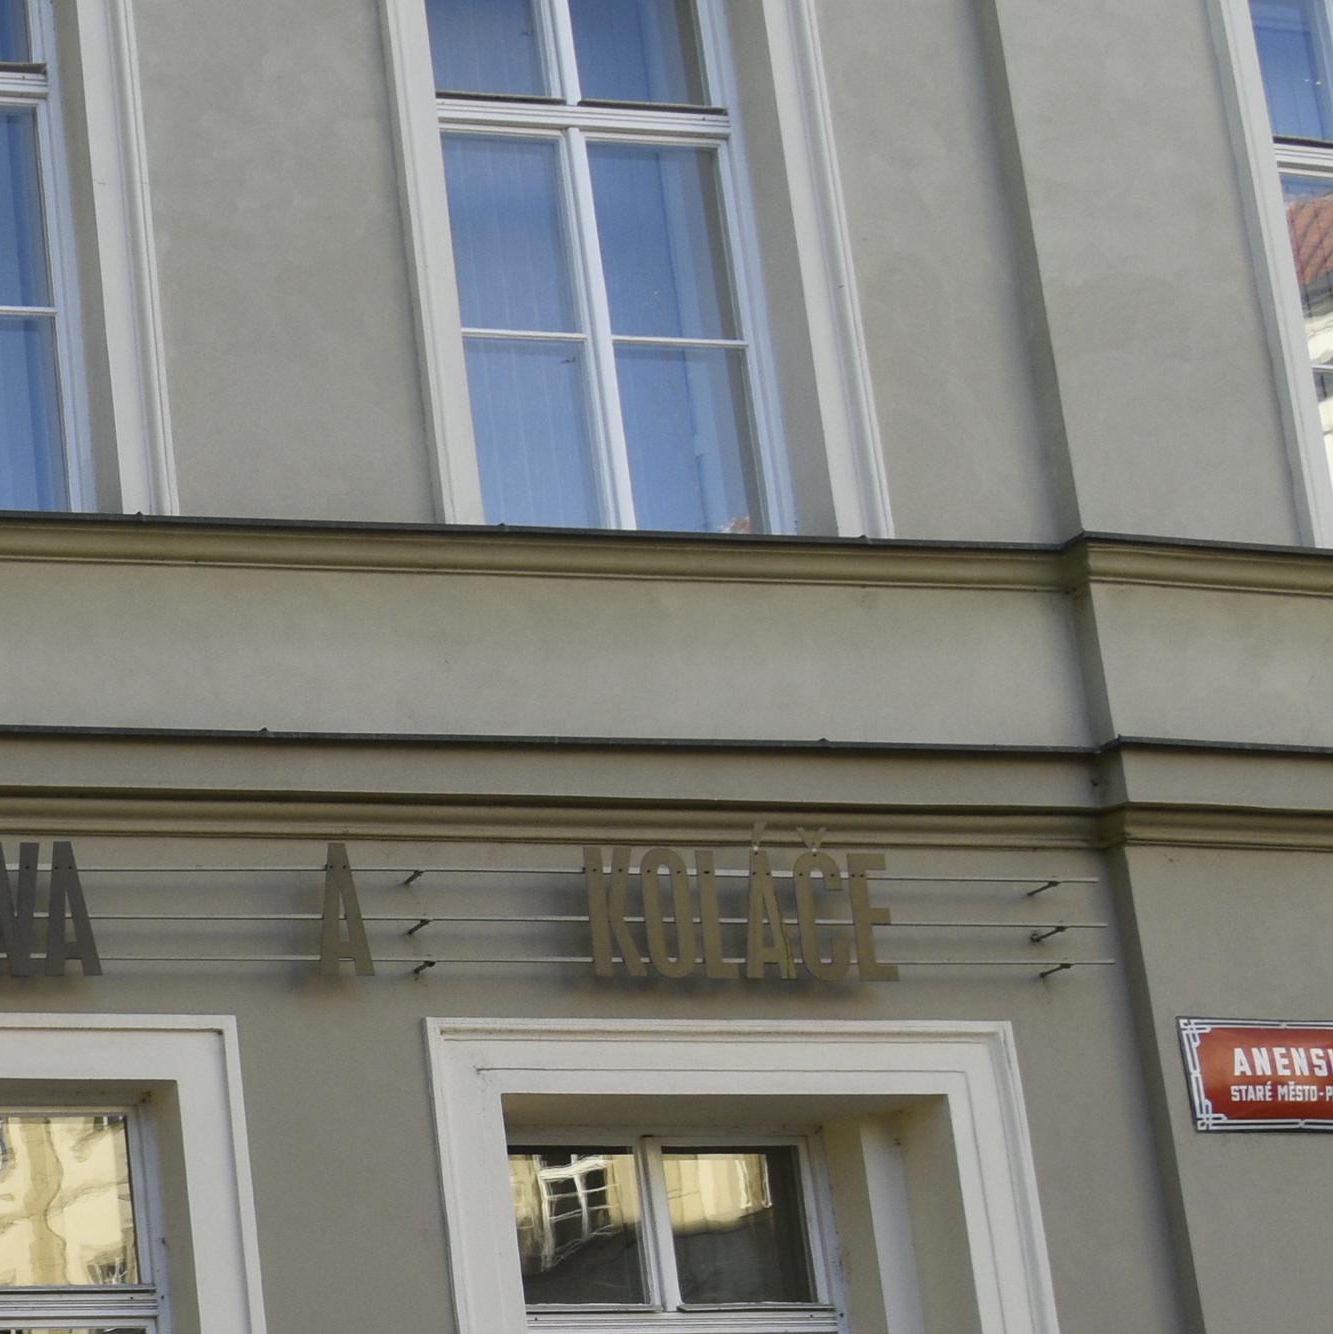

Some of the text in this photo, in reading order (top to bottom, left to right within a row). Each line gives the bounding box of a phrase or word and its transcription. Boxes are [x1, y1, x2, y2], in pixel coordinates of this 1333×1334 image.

[320, 842, 375, 976] A
[583, 821, 900, 981] KOLÁČE
[1230, 1081, 1273, 1101] STARÉ
